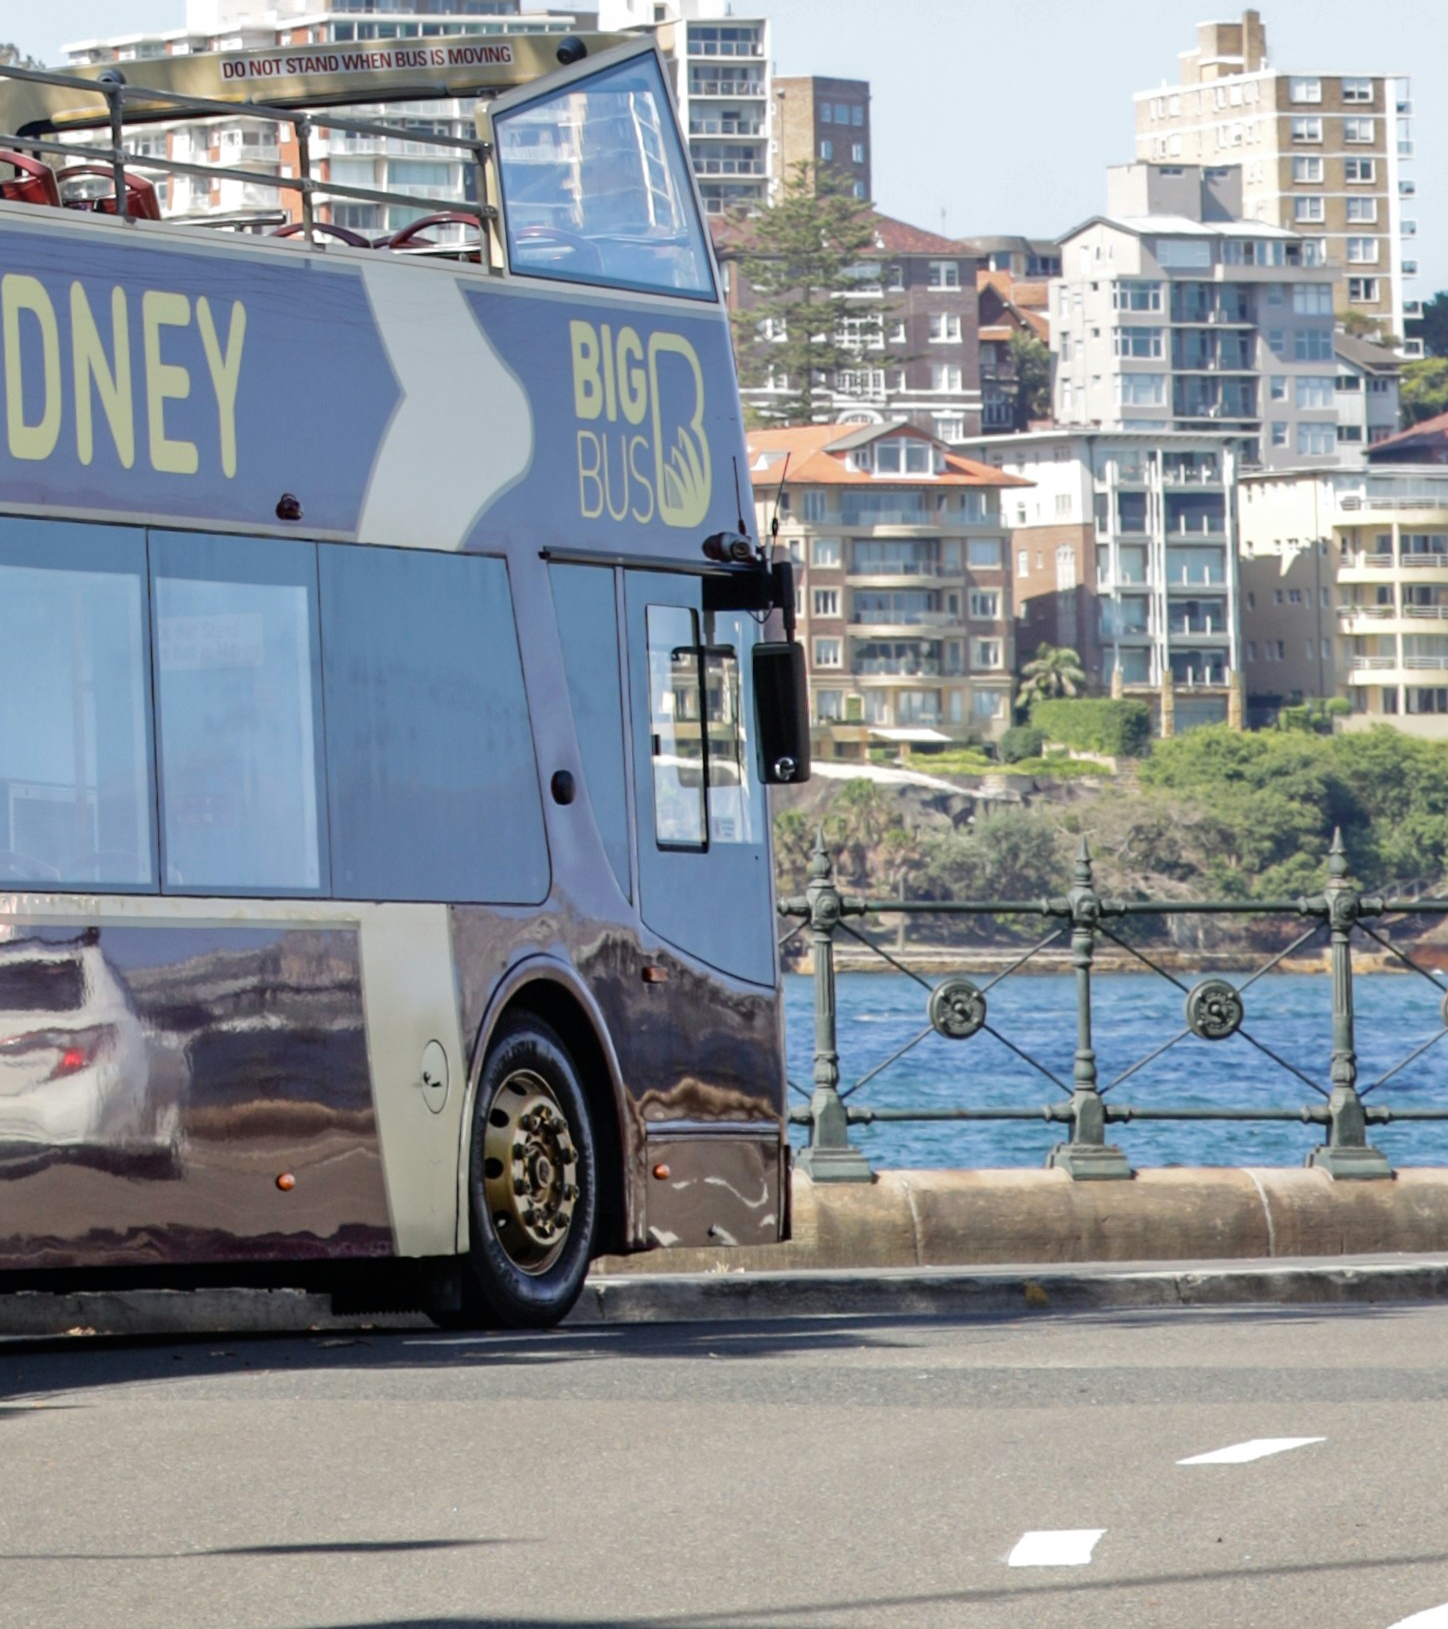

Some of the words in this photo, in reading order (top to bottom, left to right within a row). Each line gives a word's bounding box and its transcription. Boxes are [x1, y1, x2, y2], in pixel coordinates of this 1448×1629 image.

[222, 61, 246, 79] DO
[249, 59, 282, 77] NOT
[285, 55, 339, 74] STAND
[341, 52, 393, 71] WHEN
[395, 50, 427, 68] BUS
[430, 49, 445, 66] IS
[448, 45, 512, 65] MOVING
[569, 319, 648, 426] BIG
[576, 429, 654, 524] BUS
